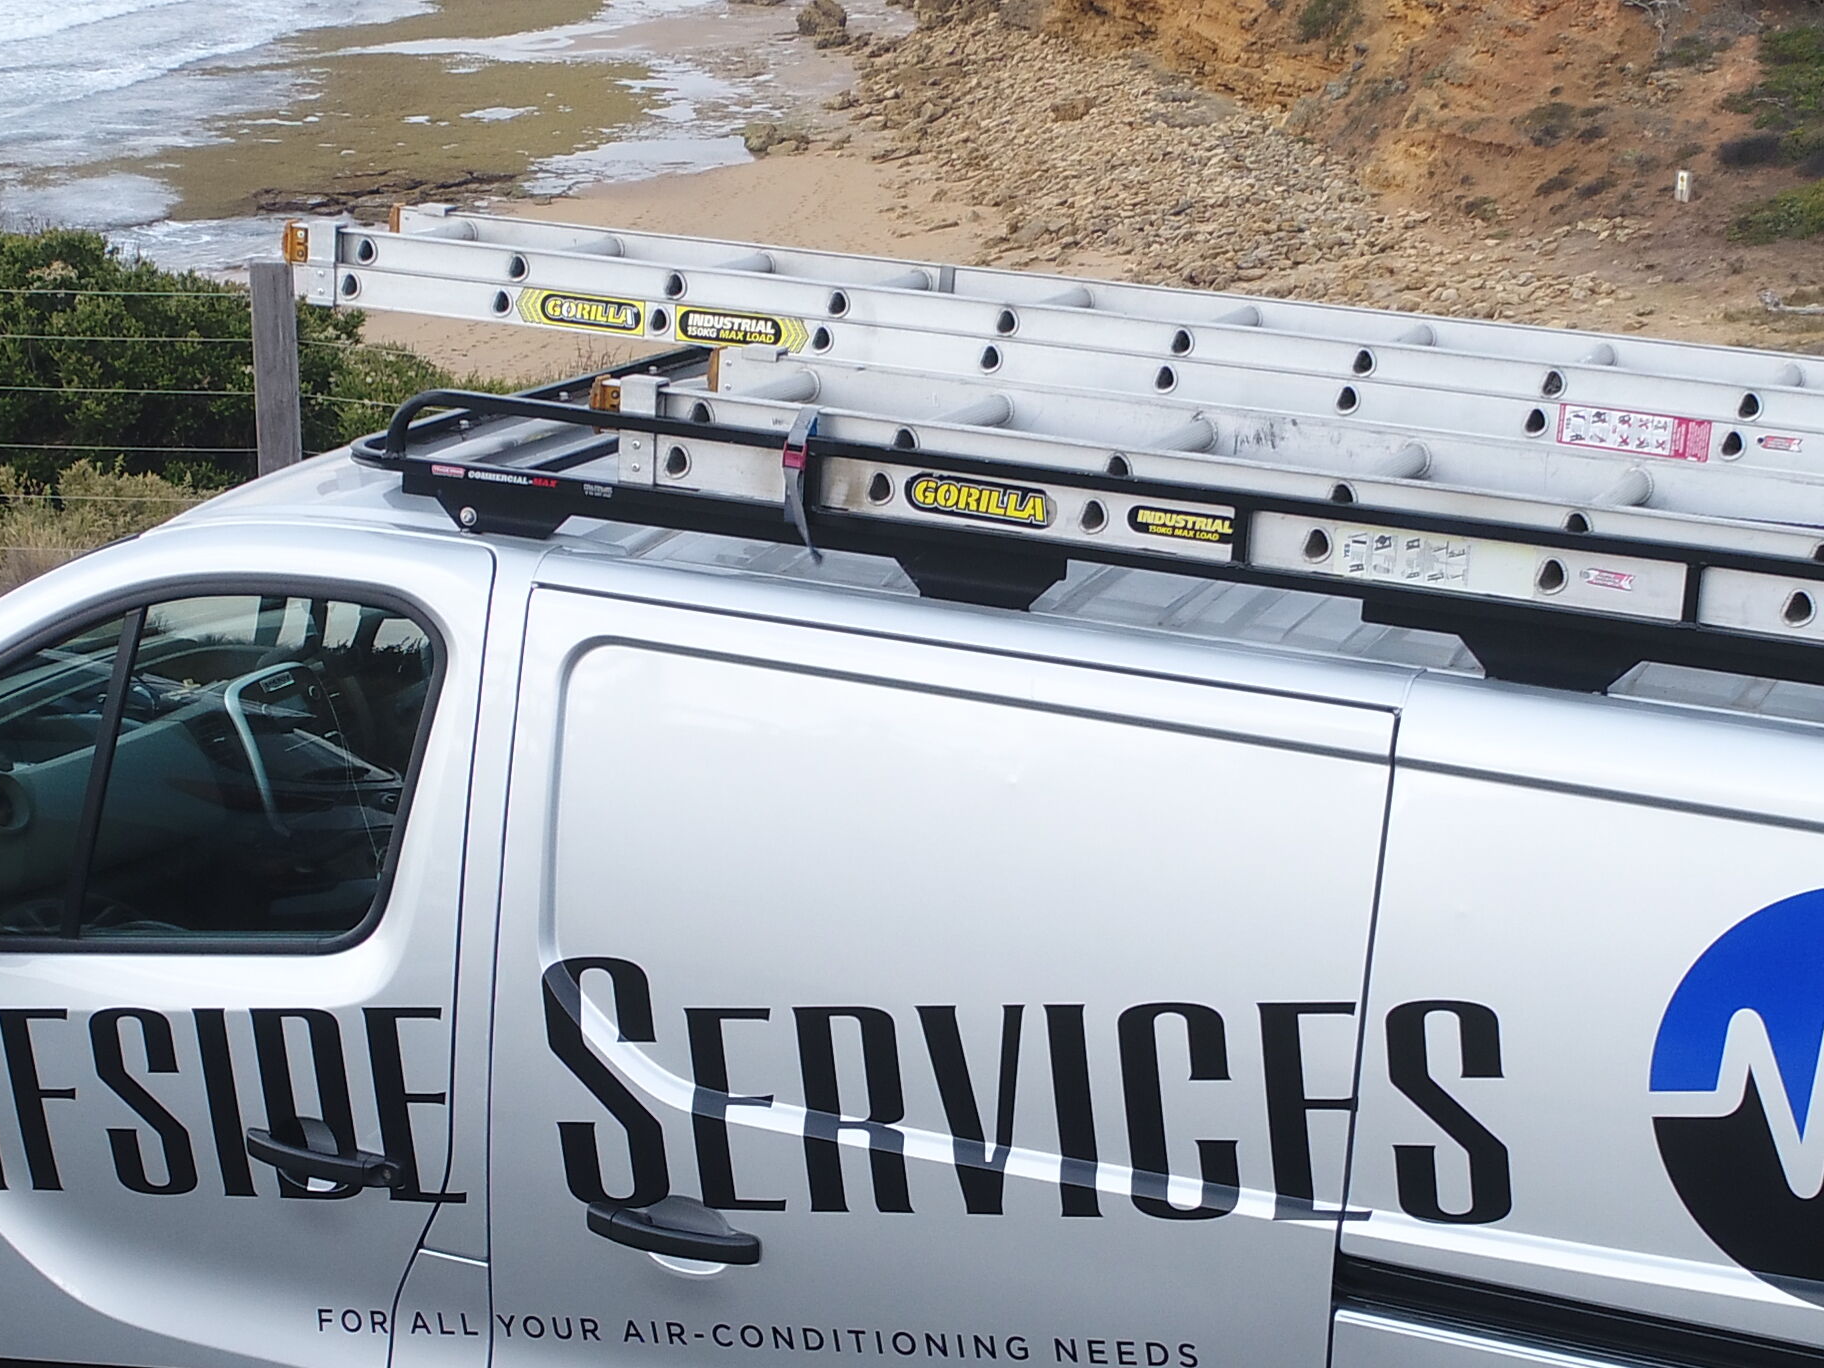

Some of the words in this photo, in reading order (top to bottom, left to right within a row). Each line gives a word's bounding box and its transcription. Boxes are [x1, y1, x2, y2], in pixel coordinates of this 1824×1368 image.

[546, 298, 636, 328] GORILLA
[688, 312, 775, 334] INDUSTRIAL
[687, 326, 717, 338] 150KG
[719, 329, 743, 341] MAX
[746, 332, 774, 343] LOAD
[913, 480, 1046, 523] GORILLA
[1136, 509, 1233, 534] INDUSTRIAL
[1148, 525, 1173, 537] 150KG
[1174, 528, 1194, 539] MAX
[1195, 530, 1219, 541] LOAD
[540, 955, 1513, 1226] SERVICES
[317, 1308, 389, 1335] FOR
[410, 1311, 479, 1337] ALL
[496, 1313, 602, 1342] YOUR
[623, 1319, 1029, 1362] AIR-CONDITIONING
[1054, 1337, 1199, 1368] NEEDS
